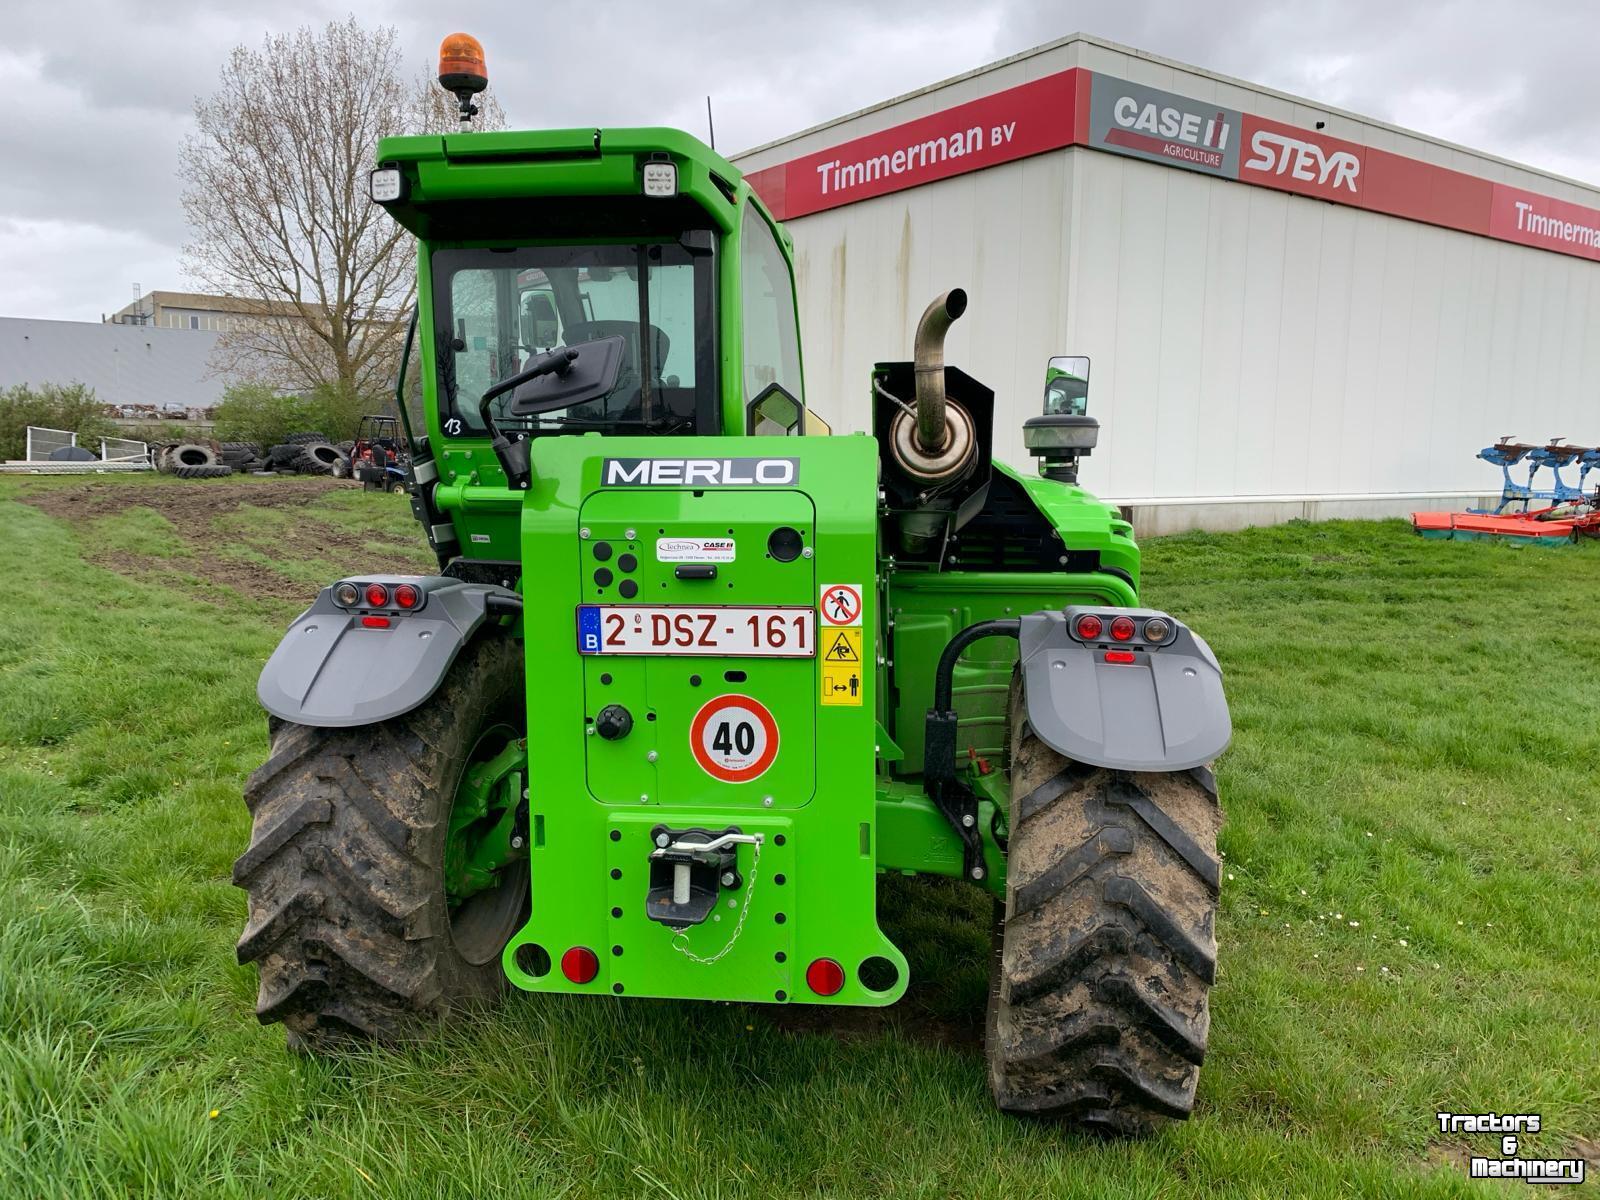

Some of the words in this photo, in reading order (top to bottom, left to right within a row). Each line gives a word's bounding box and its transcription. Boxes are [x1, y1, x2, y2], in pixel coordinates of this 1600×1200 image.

[1113, 96, 1201, 144] CASE
[817, 126, 983, 194] Timmerman
[991, 122, 1016, 146] BV
[1163, 143, 1220, 167] AGRICULTURE
[1245, 130, 1360, 192] STEYR
[444, 417, 461, 435] 13
[607, 459, 794, 485] MERLO
[586, 634, 598, 649] B
[712, 722, 755, 755] 40
